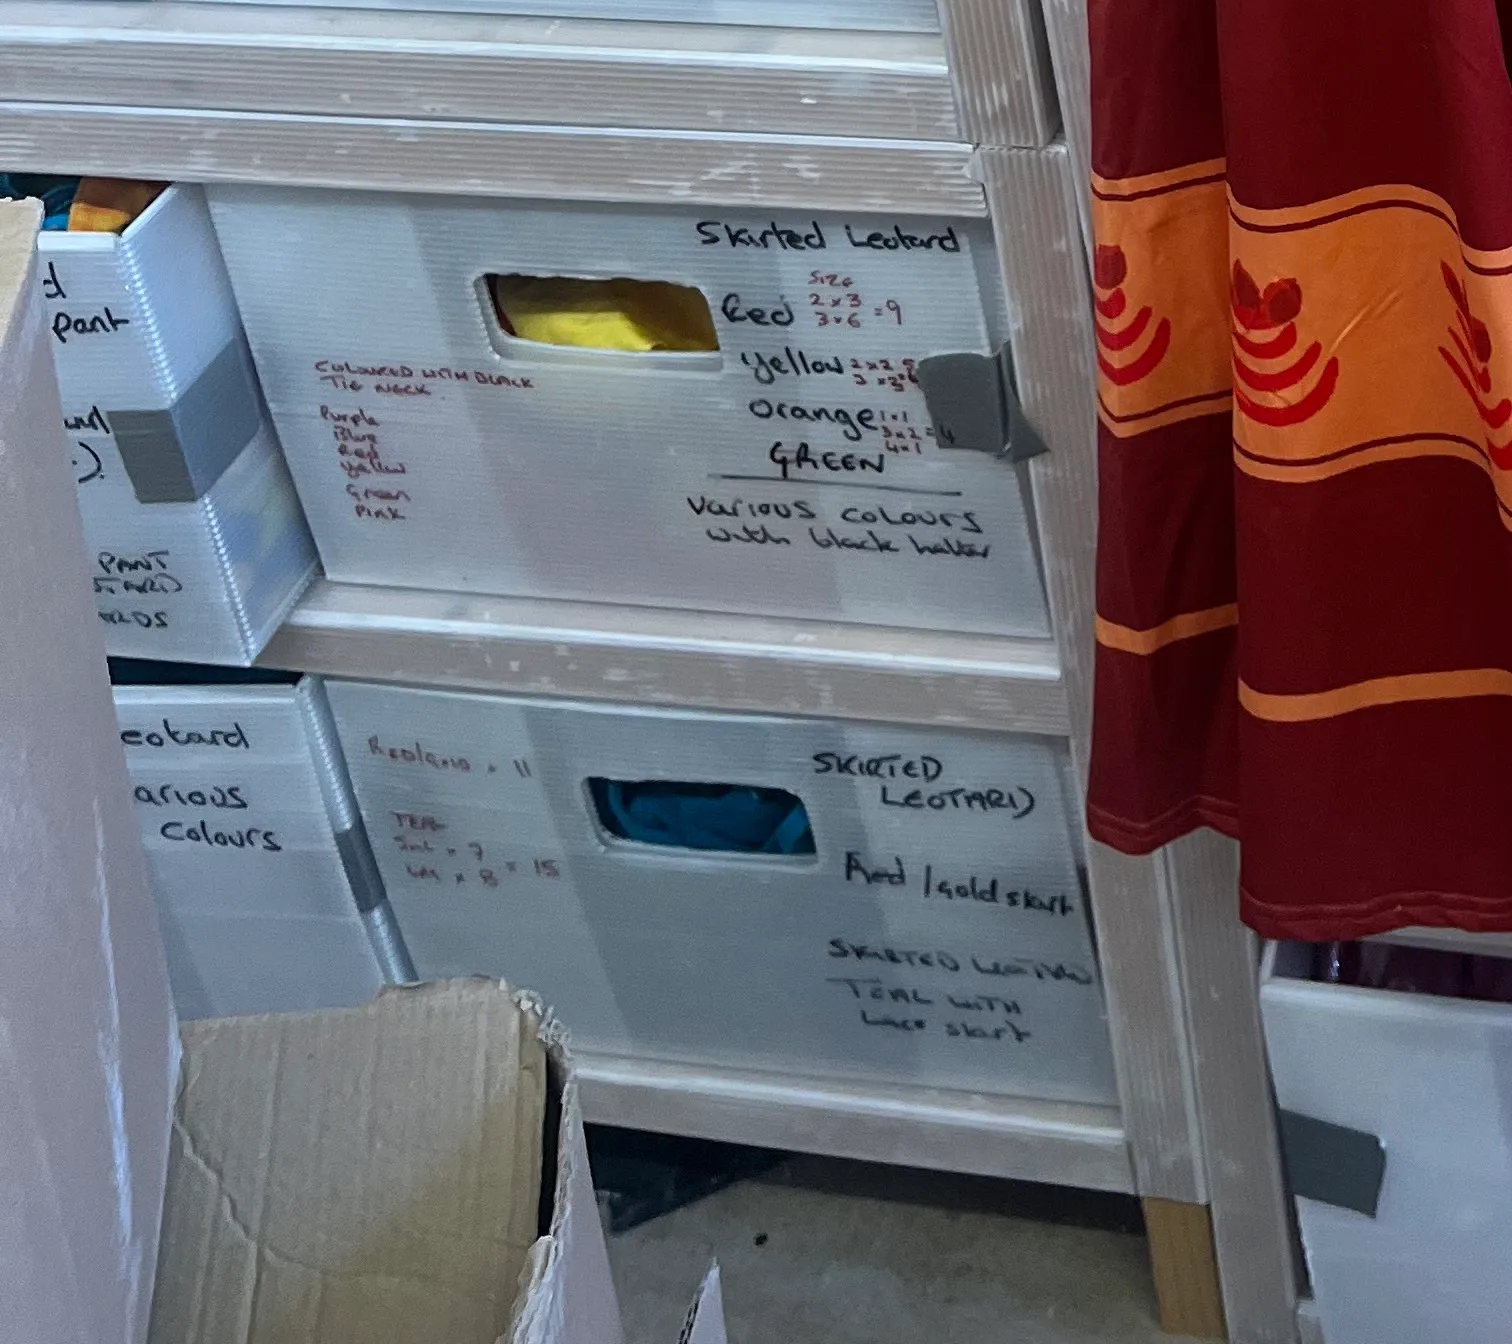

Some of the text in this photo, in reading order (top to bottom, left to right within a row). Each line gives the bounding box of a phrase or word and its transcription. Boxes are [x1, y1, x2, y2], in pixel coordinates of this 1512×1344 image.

[696, 220, 962, 254] Skirted Leotard
[721, 292, 795, 327] Red
[749, 398, 879, 442] Orange
[120, 718, 251, 749] eotard
[812, 752, 944, 782] SKIRTED
[133, 784, 249, 810] arious
